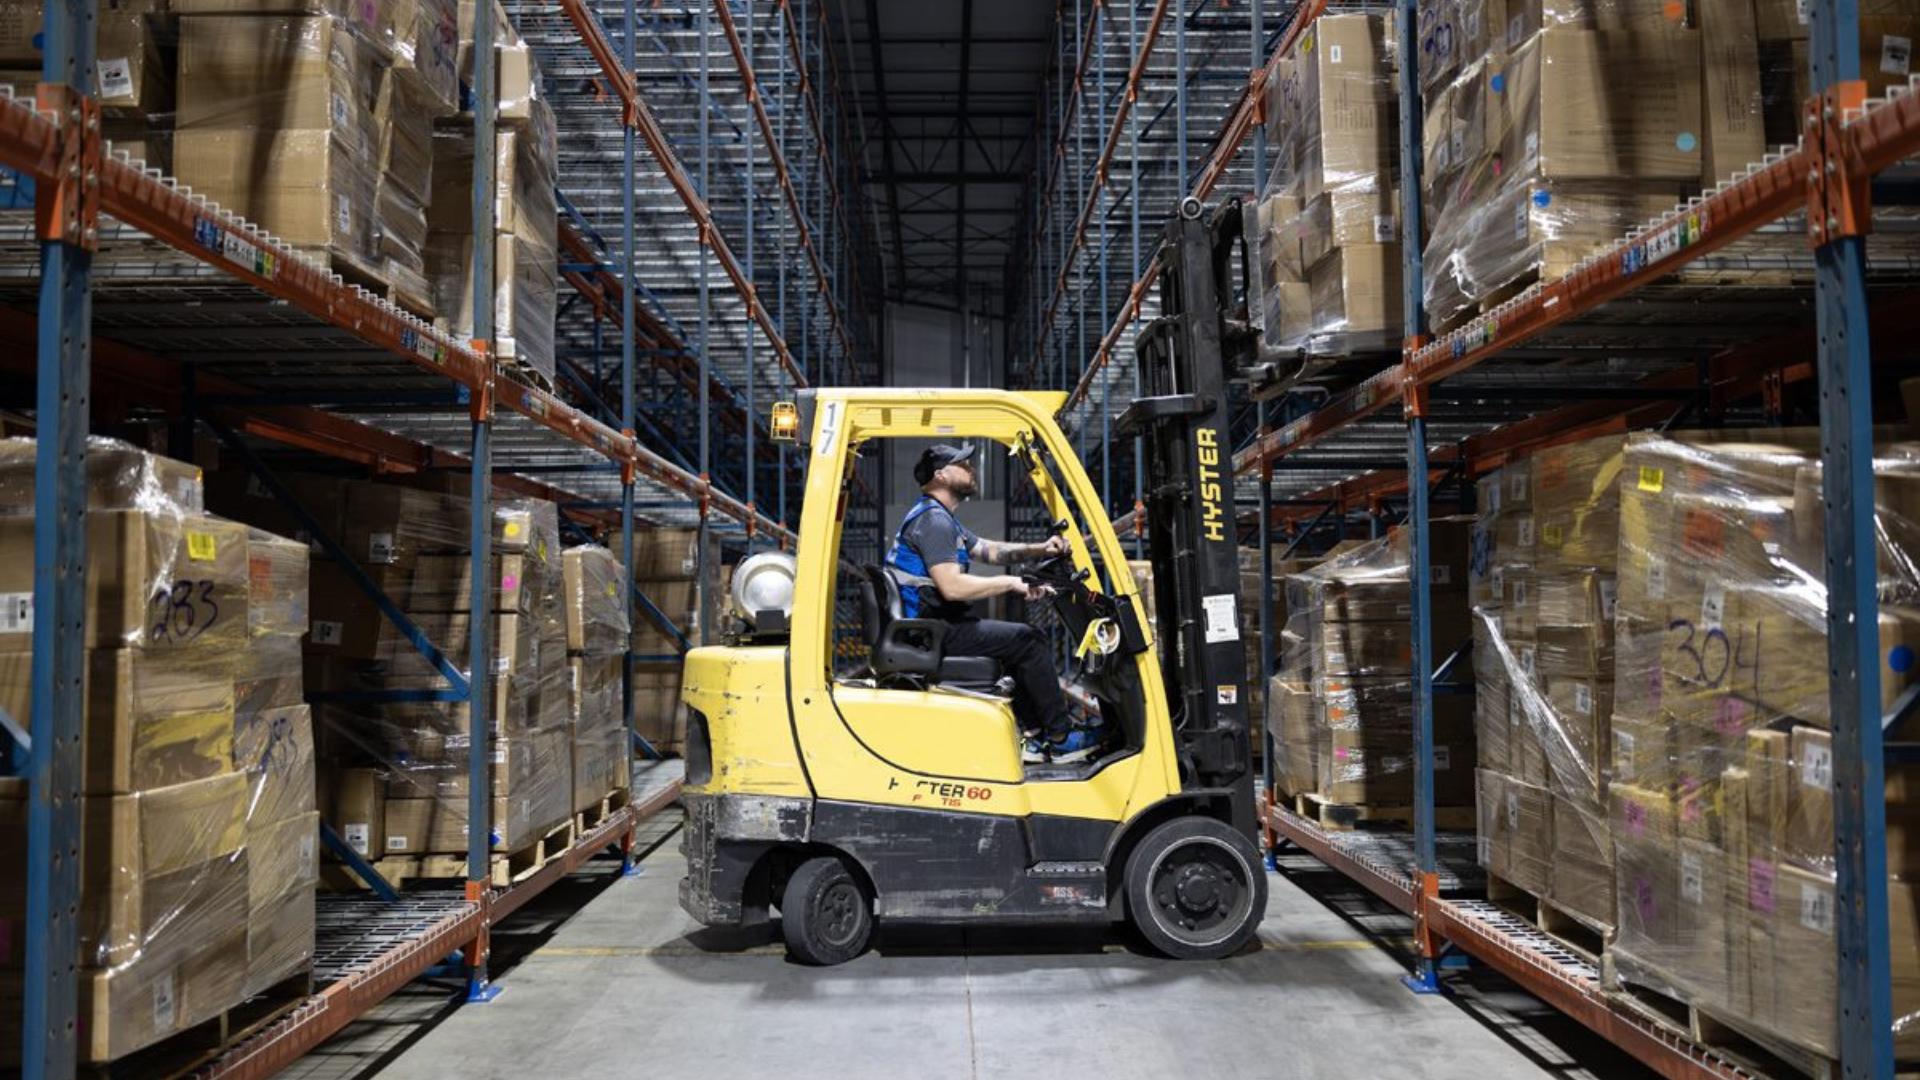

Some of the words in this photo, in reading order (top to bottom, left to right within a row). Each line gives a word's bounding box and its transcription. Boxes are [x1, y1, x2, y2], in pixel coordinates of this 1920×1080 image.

[1196, 427, 1225, 541] HYSTER
[151, 580, 218, 644] 283
[1669, 619, 1761, 726] 304
[967, 786, 992, 801] 60
